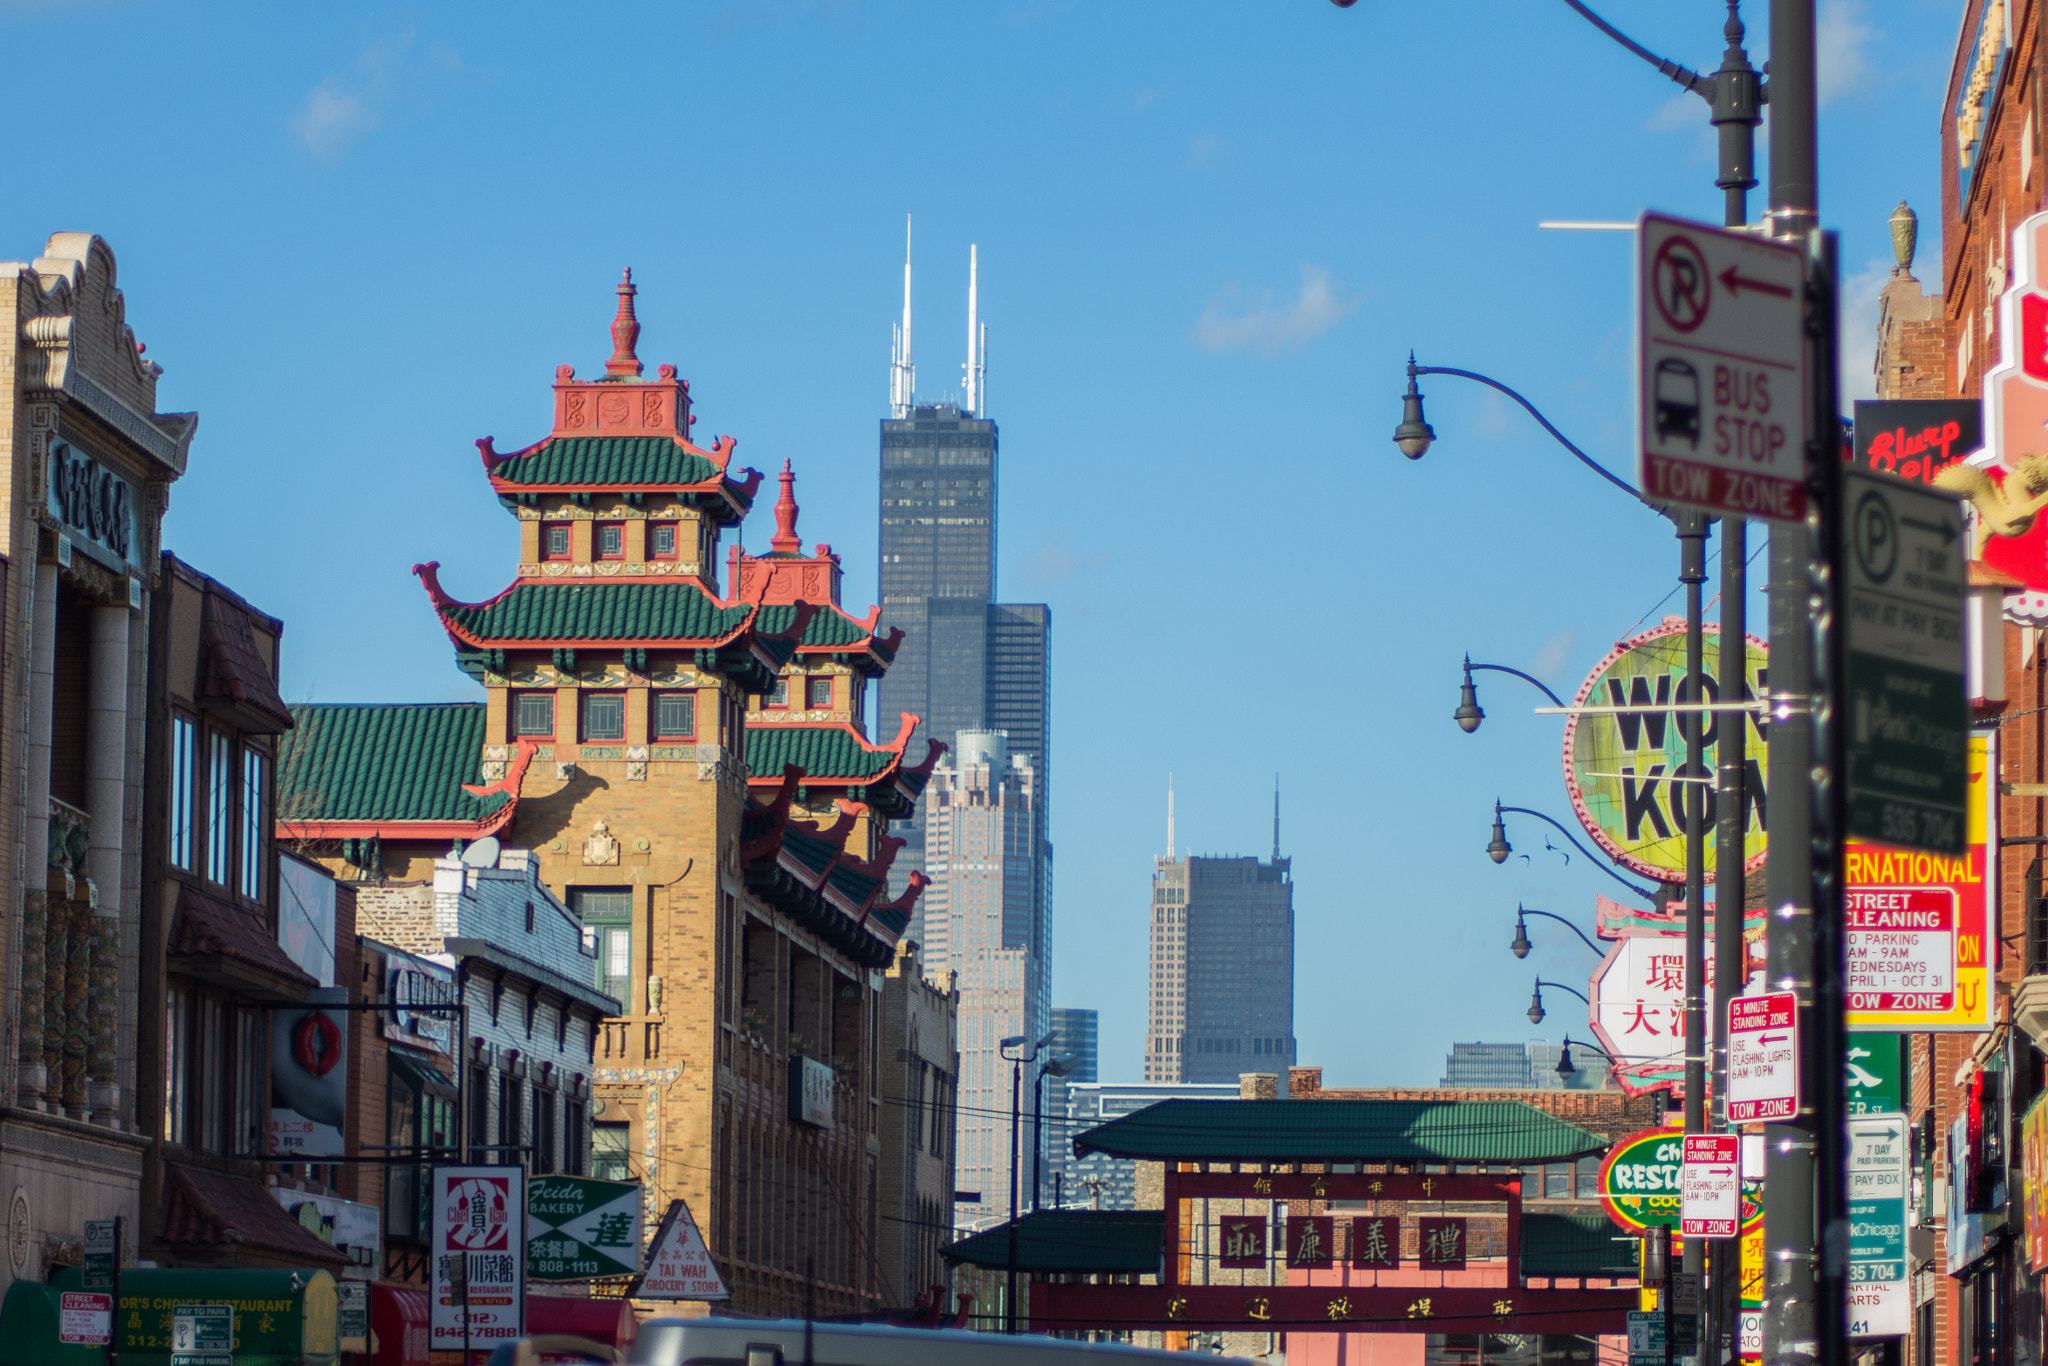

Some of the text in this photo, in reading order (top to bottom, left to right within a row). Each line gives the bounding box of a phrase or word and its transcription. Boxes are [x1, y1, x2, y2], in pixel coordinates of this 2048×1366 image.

[1714, 364, 1770, 415] BUS
[1714, 414, 1785, 465] STOP
[1867, 421, 1961, 470] Slurp
[1652, 459, 1794, 516] TOW ZONE
[1865, 934, 1919, 945] PARKING
[1848, 947, 1867, 958] AM
[1881, 947, 1909, 958] 9AM
[1847, 961, 1927, 973] EDNESDAYS
[1848, 975, 1878, 987] PRIL
[1901, 975, 1926, 987] OCT
[1931, 975, 1943, 987] 31
[1733, 1000, 1769, 1015] 15 MINUTE
[1849, 993, 1943, 1009] OW ZONE
[1733, 1012, 1789, 1029] STANDING ZONE
[1732, 1040, 1745, 1052] USE
[1732, 1049, 1791, 1066] FLASHING LIGHTS
[1732, 1099, 1790, 1118] TOW ZONE
[1872, 1105, 1882, 1114] ST
[1686, 1139, 1717, 1149] 15 MINUTE
[1866, 1144, 1891, 1155] 7 DAY
[1686, 1151, 1732, 1160] STANDING ZONE
[1857, 1156, 1901, 1165] PAID PARKING
[1686, 1169, 1697, 1179] USE
[1855, 1173, 1899, 1186] PAY BOX
[528, 1179, 584, 1201] Feida
[1686, 1181, 1734, 1190] FLASHING LIGHTS
[529, 1203, 584, 1214] BAKERY
[586, 1212, 634, 1247] 達
[1685, 1221, 1731, 1233] TOW ZONE
[530, 1240, 579, 1258] 茶餐廳
[438, 1254, 514, 1282] 寶川菜館
[539, 1260, 599, 1273] 808-1113
[659, 1264, 706, 1279] TAI WAH
[1850, 1264, 1895, 1280] 35 704
[646, 1279, 719, 1292] GROCERY STORE
[65, 1302, 105, 1310] CLEANING
[177, 1307, 227, 1315] PAY TO PARK
